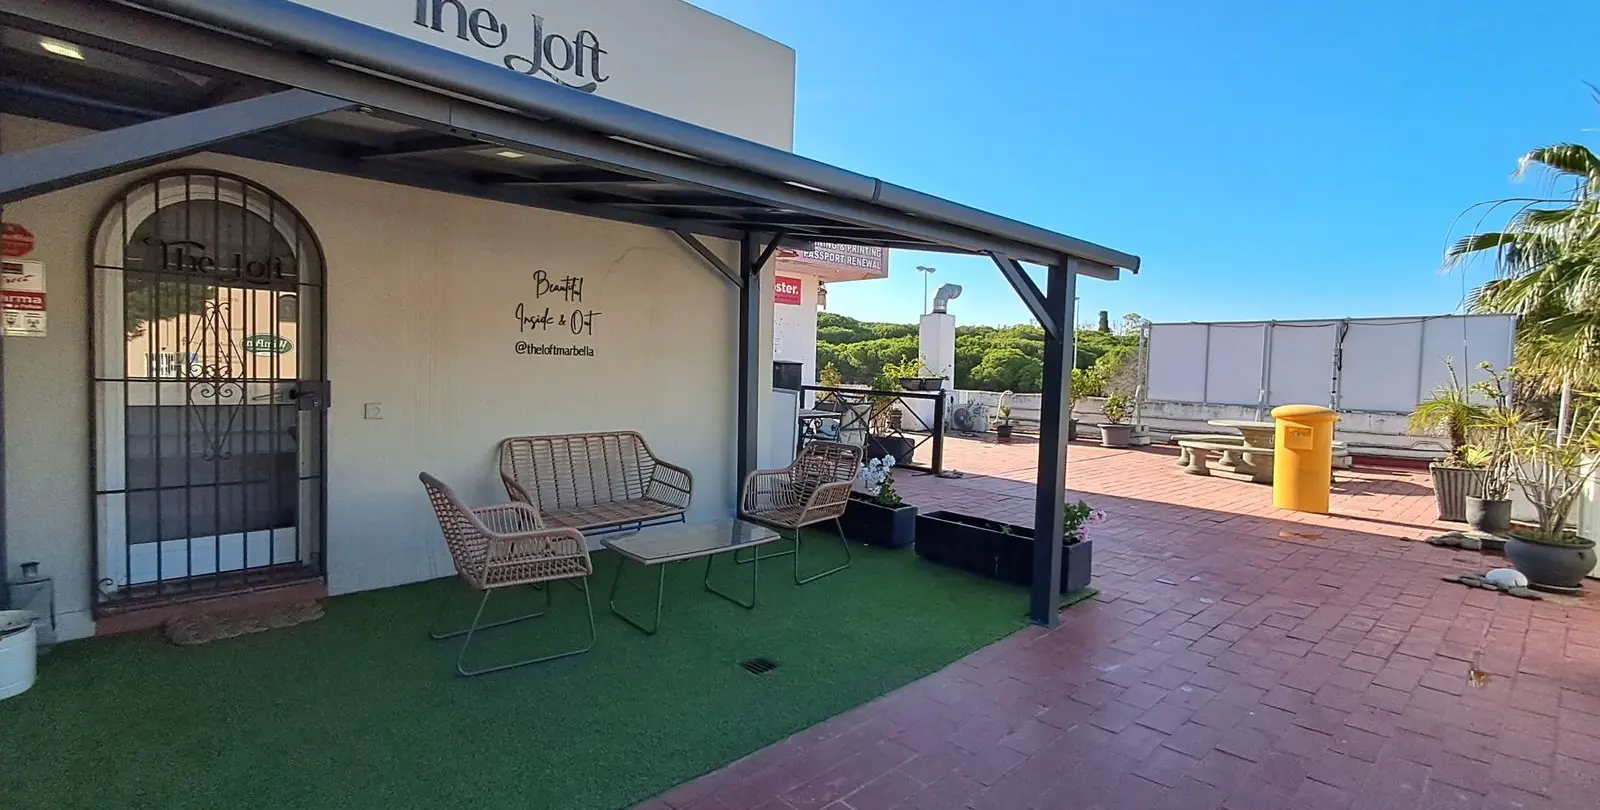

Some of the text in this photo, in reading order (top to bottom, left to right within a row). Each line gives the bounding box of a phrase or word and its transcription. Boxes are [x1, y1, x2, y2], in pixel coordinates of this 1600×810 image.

[503, 14, 609, 93] Loft
[143, 236, 216, 274] The
[803, 251, 882, 270] PASSPORT RENEWAL
[839, 243, 845, 251] &
[847, 244, 882, 258] PRINTING
[533, 269, 584, 302] Beautiful
[775, 282, 799, 295] ster.
[515, 302, 602, 335] Inside & Out
[515, 340, 594, 357] @theloftmarbella
